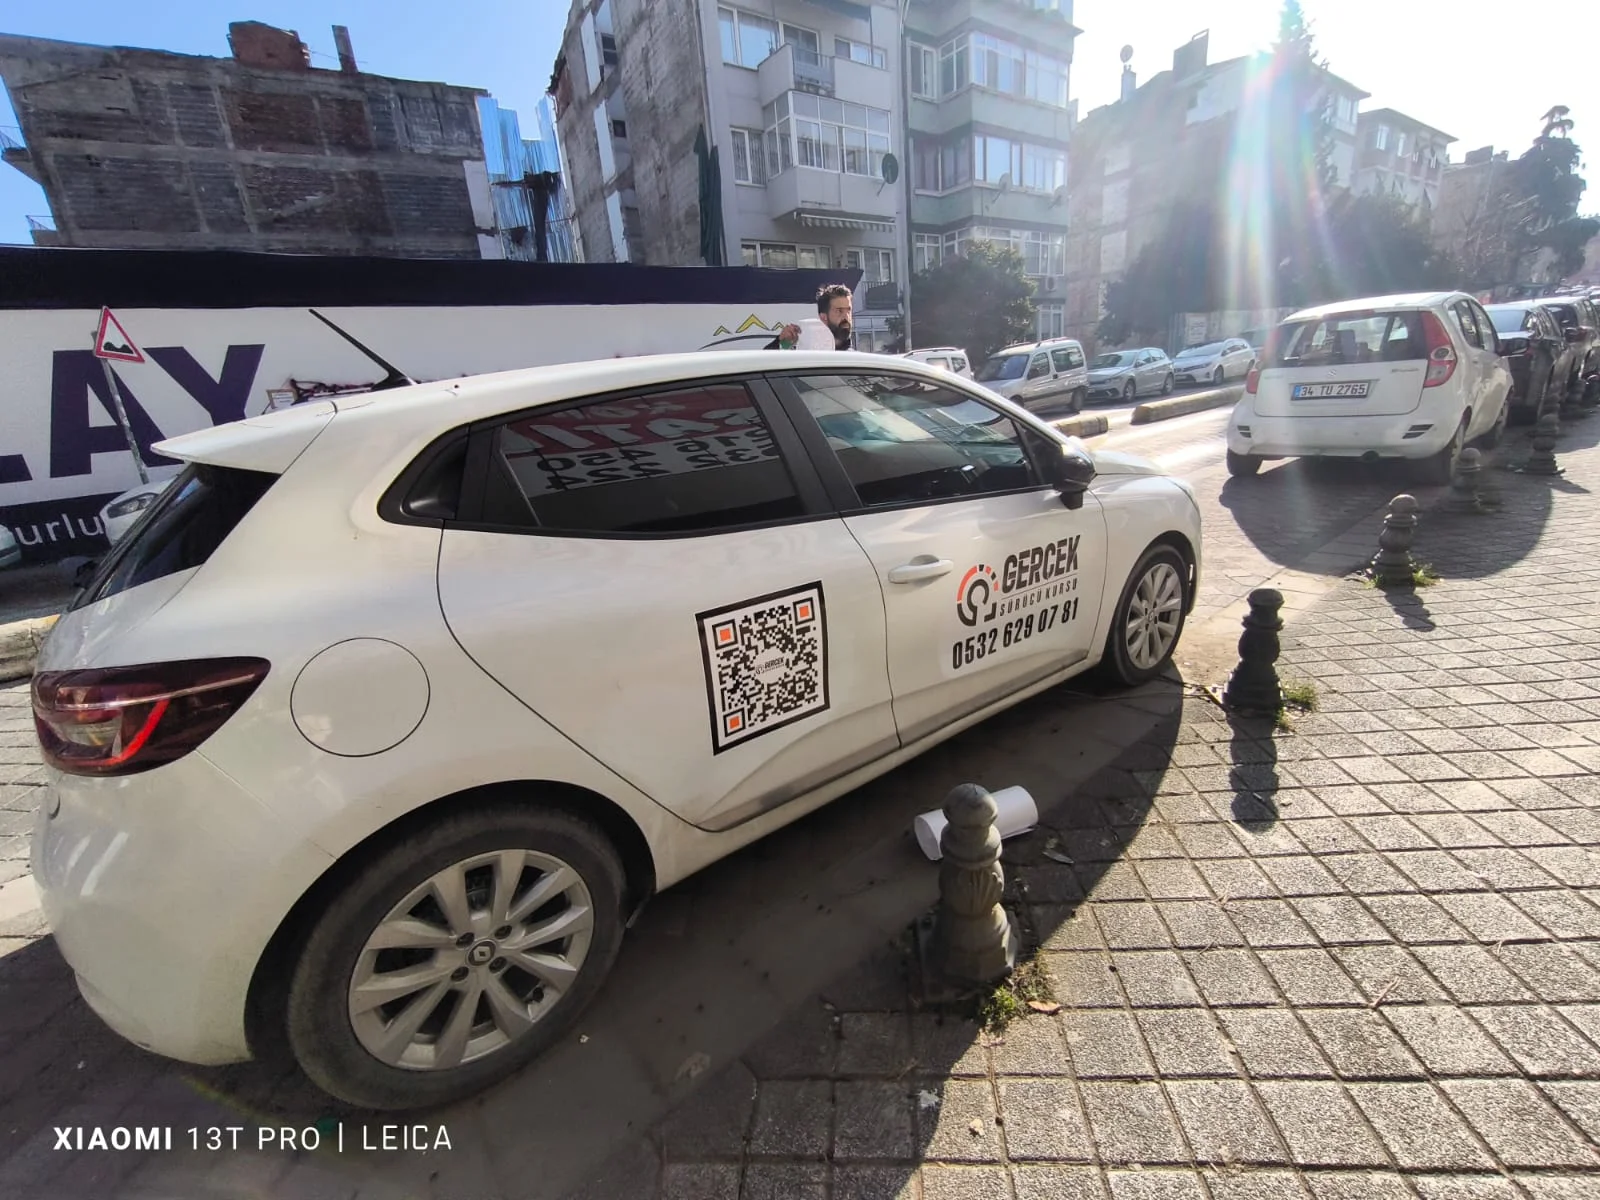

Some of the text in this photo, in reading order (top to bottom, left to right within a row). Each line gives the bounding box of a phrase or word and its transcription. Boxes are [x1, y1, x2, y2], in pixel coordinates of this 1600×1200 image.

[1300, 383, 1366, 397] 34 TU 2765
[0, 344, 265, 484] AY
[1045, 578, 1078, 600] KURSU
[952, 597, 1079, 670] 0532 629 07 81
